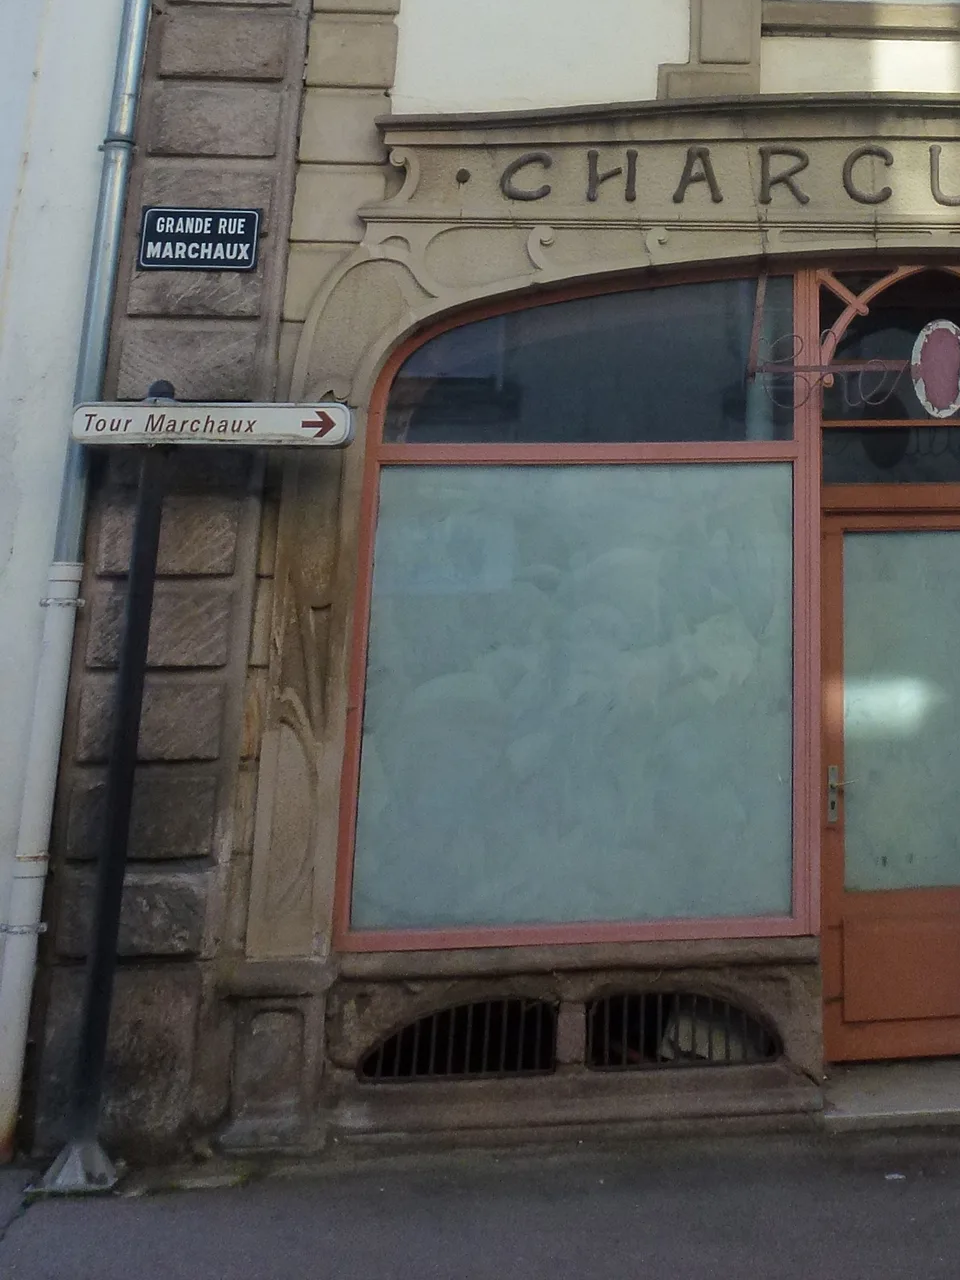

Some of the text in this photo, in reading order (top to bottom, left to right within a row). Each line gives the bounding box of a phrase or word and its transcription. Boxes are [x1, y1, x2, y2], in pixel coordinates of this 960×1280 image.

[155, 216, 246, 235] GRANDE RUE
[146, 241, 250, 261] MARCHAUX
[84, 413, 258, 434] Tour Marchaux
